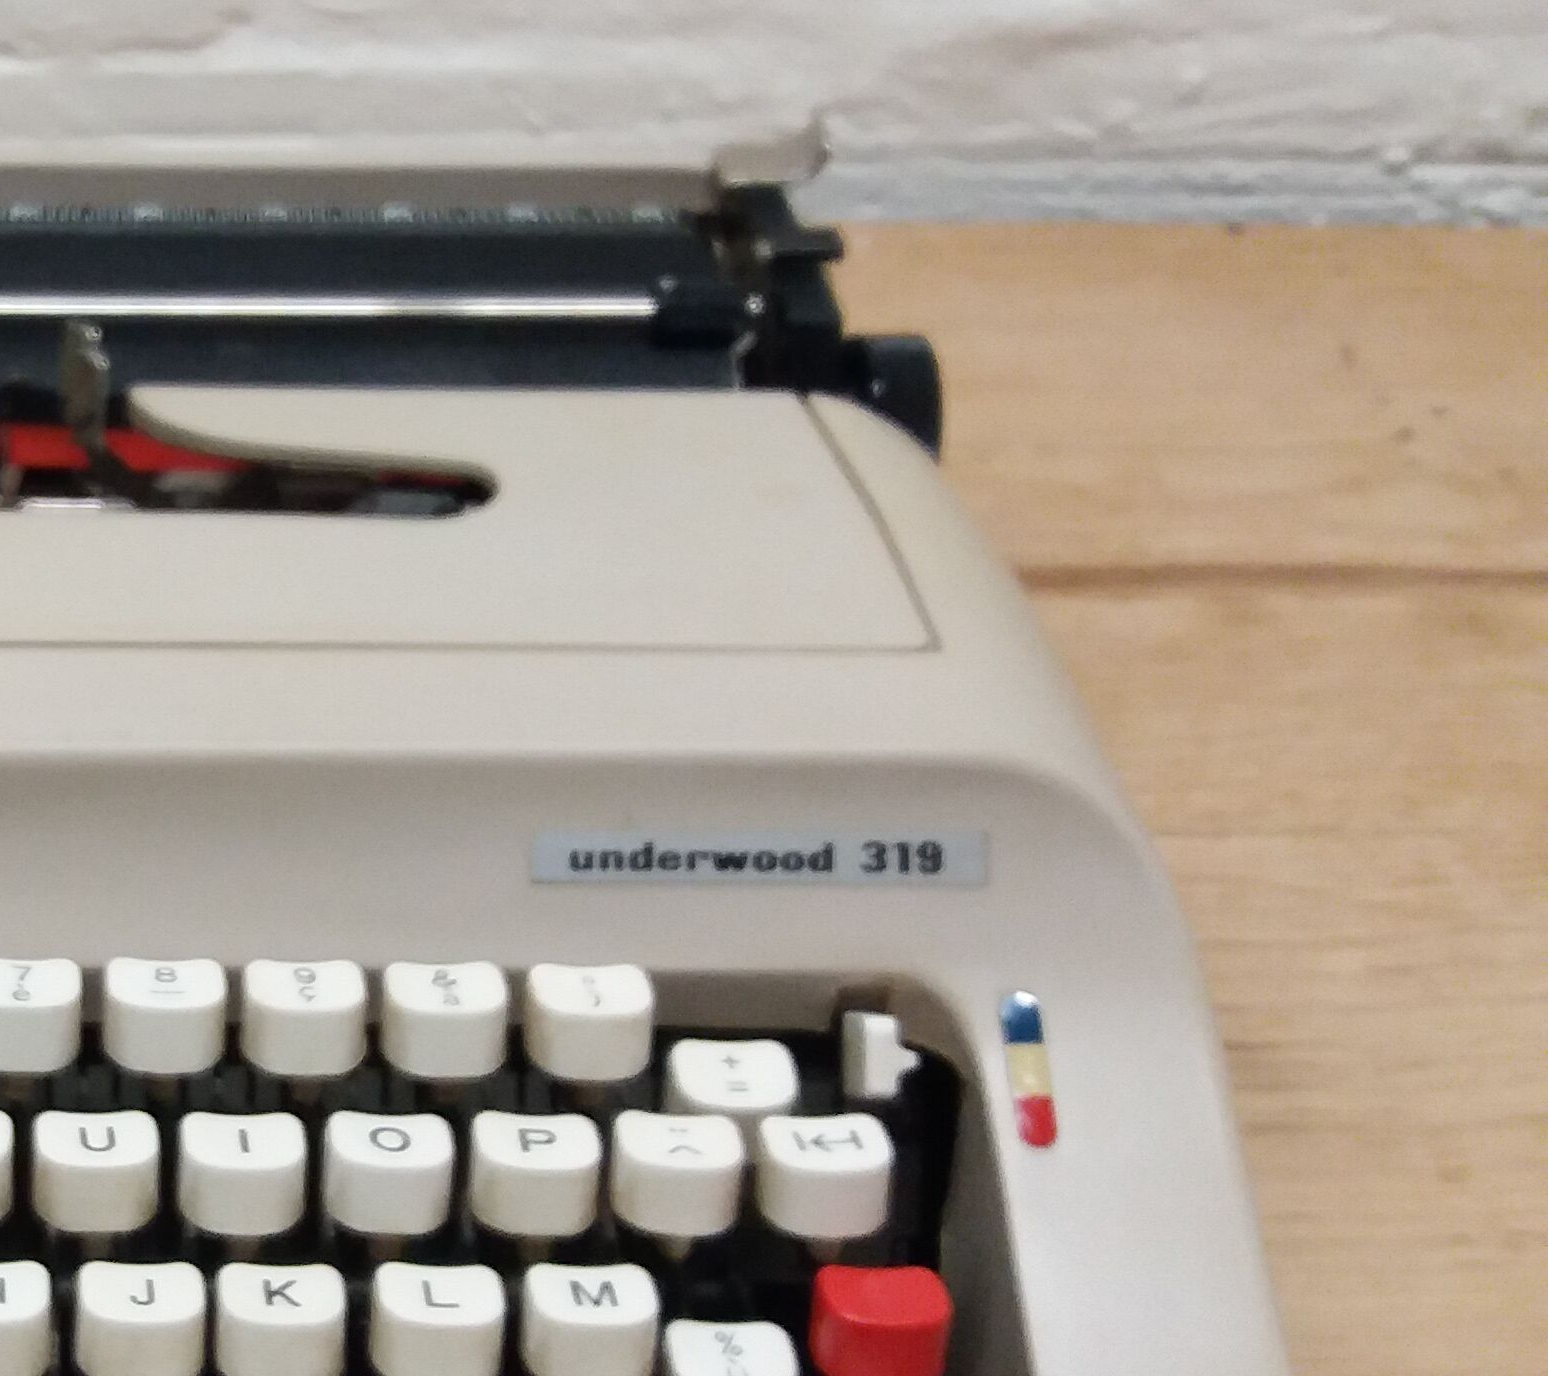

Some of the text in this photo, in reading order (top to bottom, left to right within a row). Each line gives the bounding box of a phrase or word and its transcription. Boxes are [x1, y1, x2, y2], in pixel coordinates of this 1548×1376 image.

[568, 839, 945, 876] underwood 319
[11, 965, 32, 982] 7
[154, 966, 179, 983] 8
[79, 1126, 116, 1152] U
[237, 1128, 251, 1154] I
[368, 1126, 412, 1153] O
[518, 1127, 558, 1153] P
[128, 1278, 156, 1307] J
[261, 1278, 303, 1308] K
[420, 1279, 461, 1309] L
[568, 1279, 619, 1308] M
